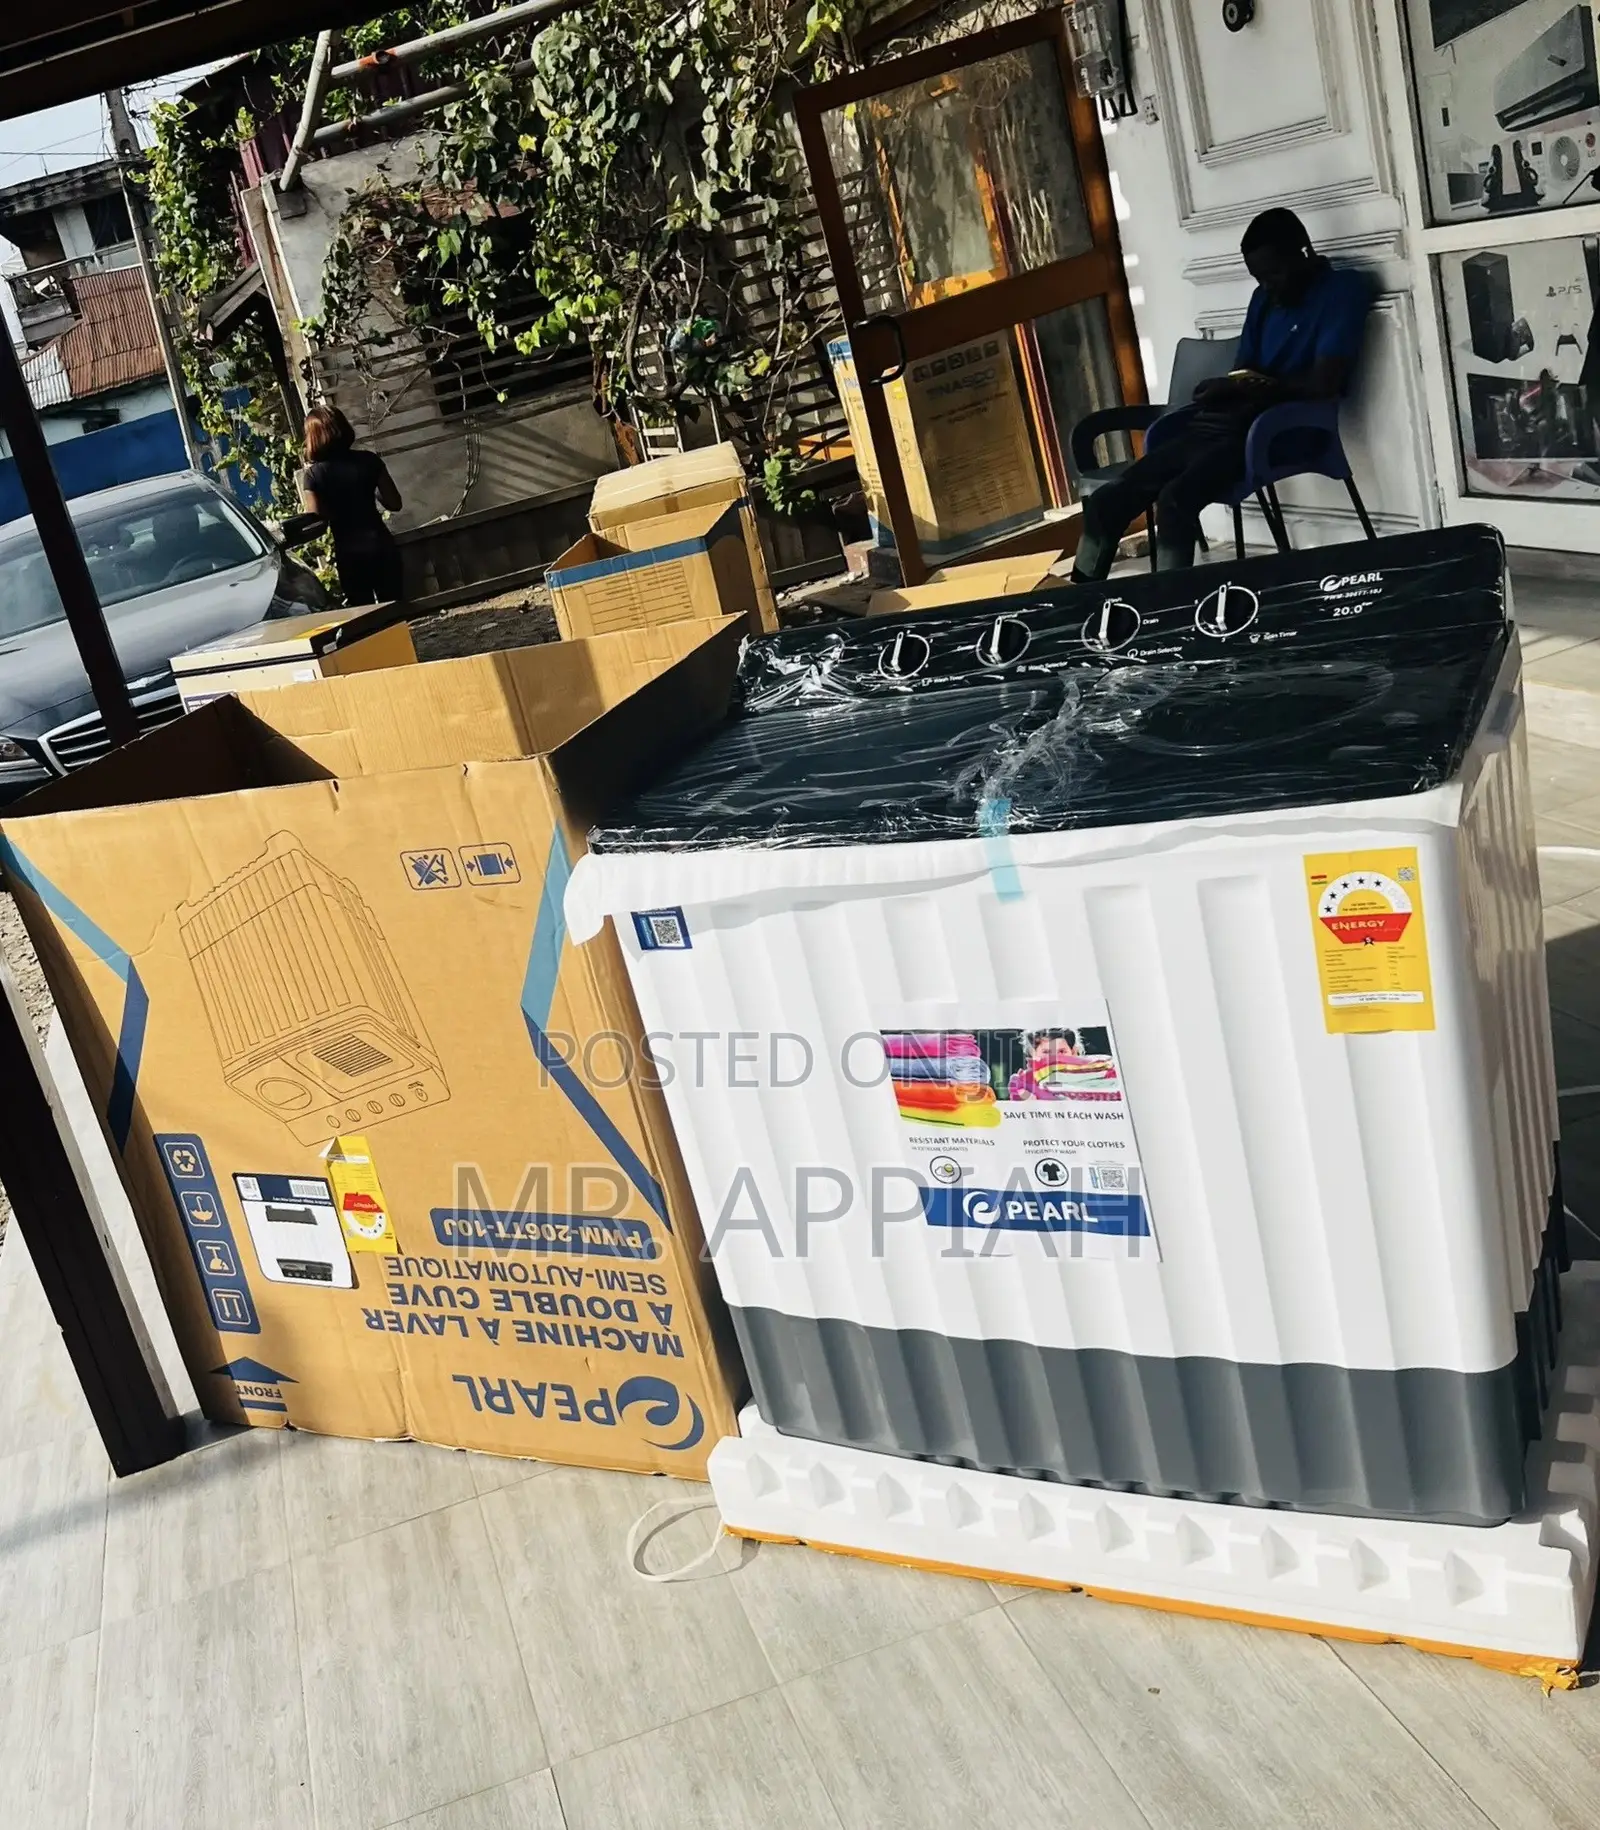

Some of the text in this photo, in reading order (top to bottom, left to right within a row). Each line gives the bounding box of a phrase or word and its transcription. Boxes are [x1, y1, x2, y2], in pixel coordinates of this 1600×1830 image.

[1341, 571, 1384, 587] PEARL
[1331, 920, 1386, 931] ENERGY
[1003, 1111, 1124, 1120] SAVE TIME IN EACH WASH
[908, 1137, 996, 1146] RESISTANT MATERIALS
[1023, 1139, 1126, 1149] PROTECT YOUR CLOTHES
[1005, 1201, 1099, 1223] PEARL
[442, 1217, 644, 1249] PWM-206TT-10J
[386, 1256, 667, 1297] SEMI-AUTOMATIQUE
[386, 1282, 674, 1332] À DOUBLE CUVE
[363, 1307, 685, 1358] MACHINE À LAVER
[236, 1385, 283, 1399] FRONT
[451, 1374, 618, 1426] PEARL
